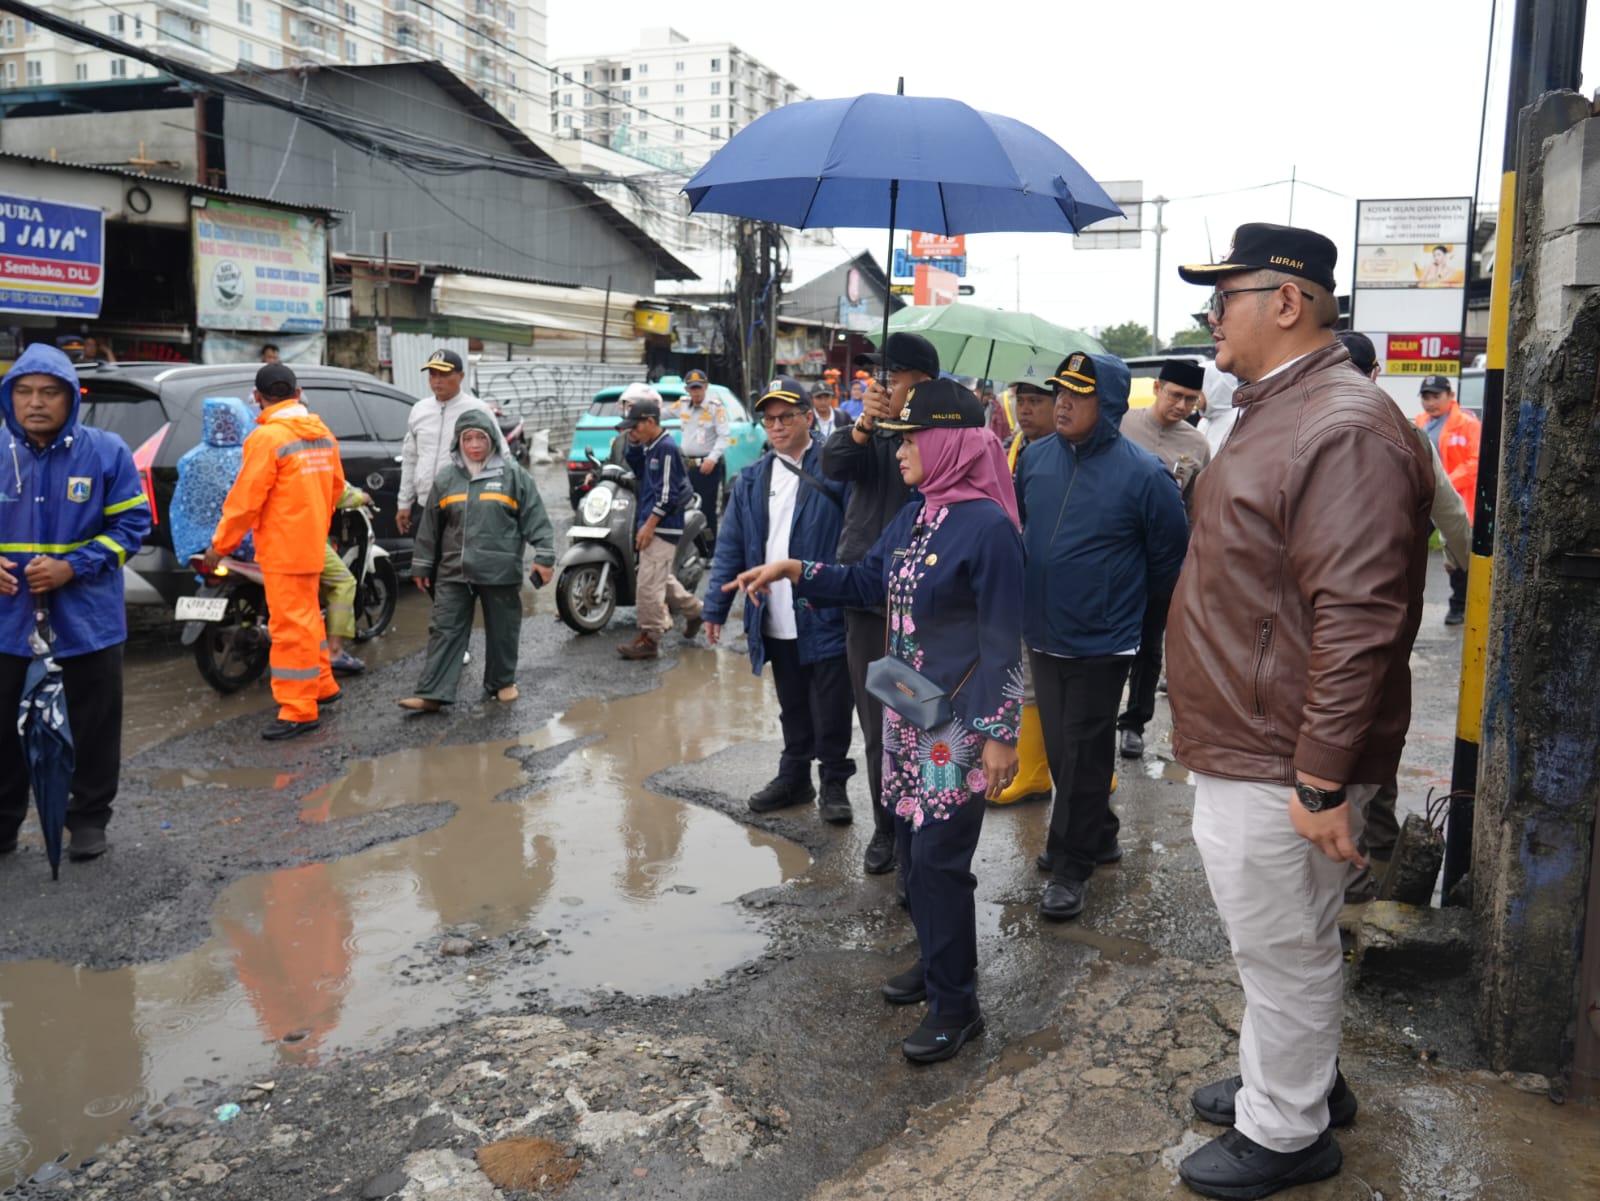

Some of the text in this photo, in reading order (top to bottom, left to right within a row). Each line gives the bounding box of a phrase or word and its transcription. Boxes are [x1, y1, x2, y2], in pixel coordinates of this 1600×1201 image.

[4, 260, 92, 281] Sembako, DLL
[1270, 255, 1305, 270] LURAH
[1420, 337, 1442, 358] 10
